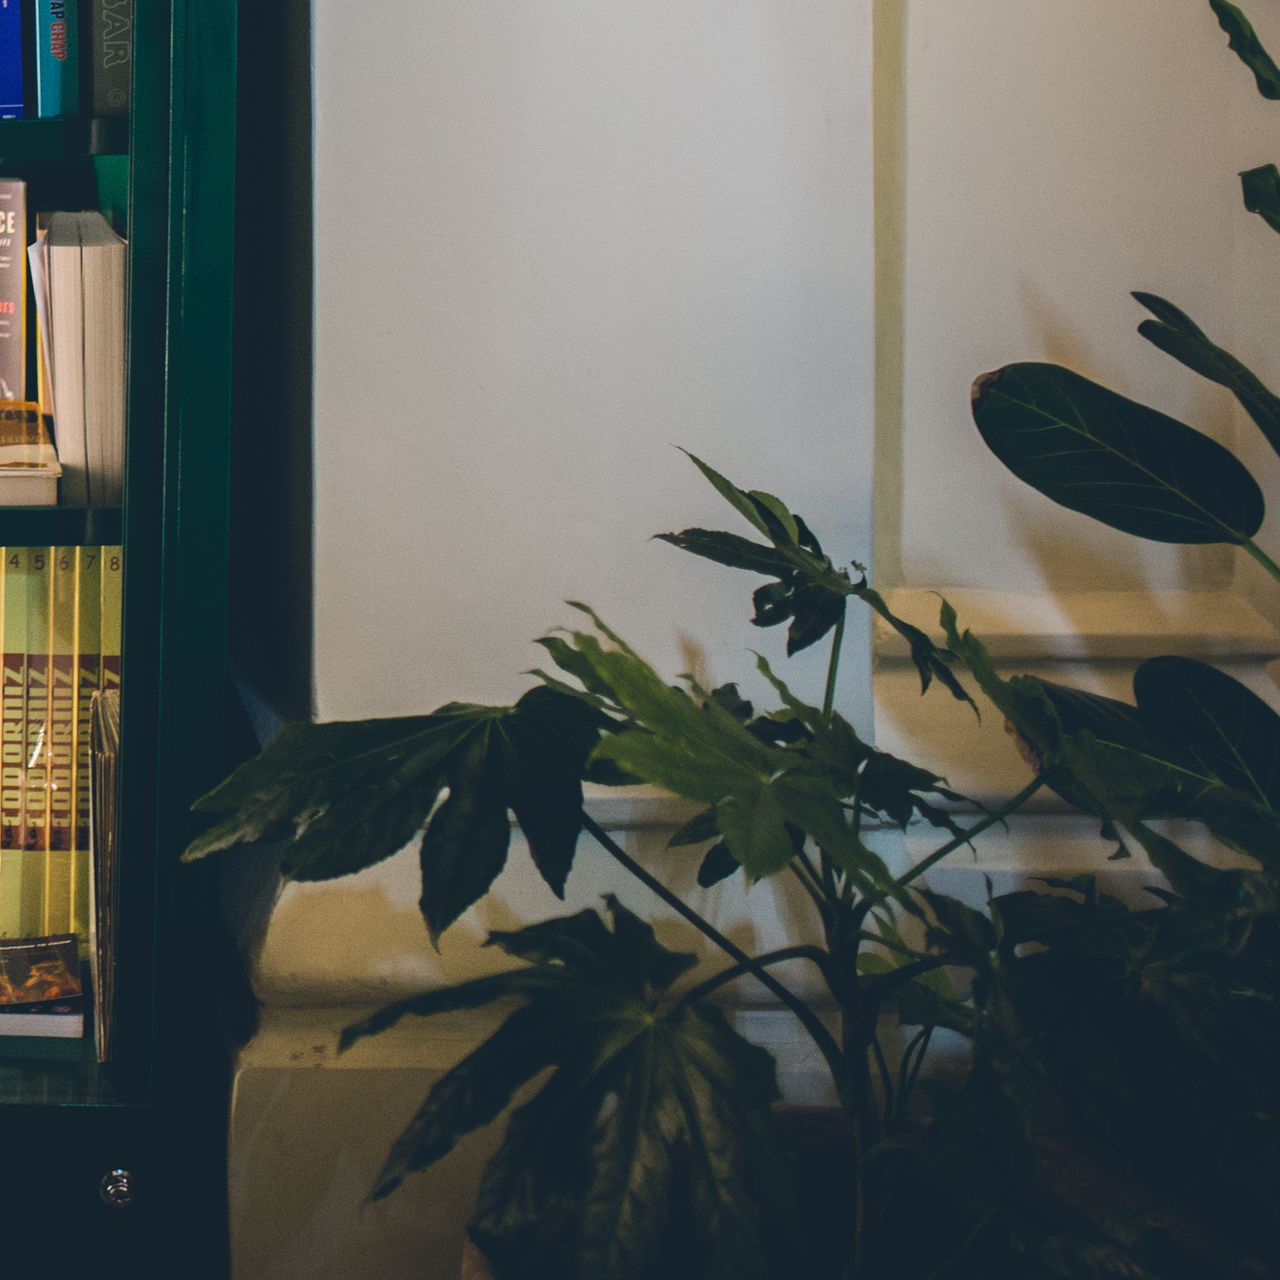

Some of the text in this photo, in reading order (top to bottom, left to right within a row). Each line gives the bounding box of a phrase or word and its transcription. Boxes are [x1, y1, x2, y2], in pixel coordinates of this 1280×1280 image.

[51, 21, 67, 60] CHAP
[8, 554, 21, 570] 4
[34, 554, 45, 571] 5
[58, 554, 70, 571] 6
[108, 556, 121, 572] 8
[2, 666, 23, 826] CODORNIZ
